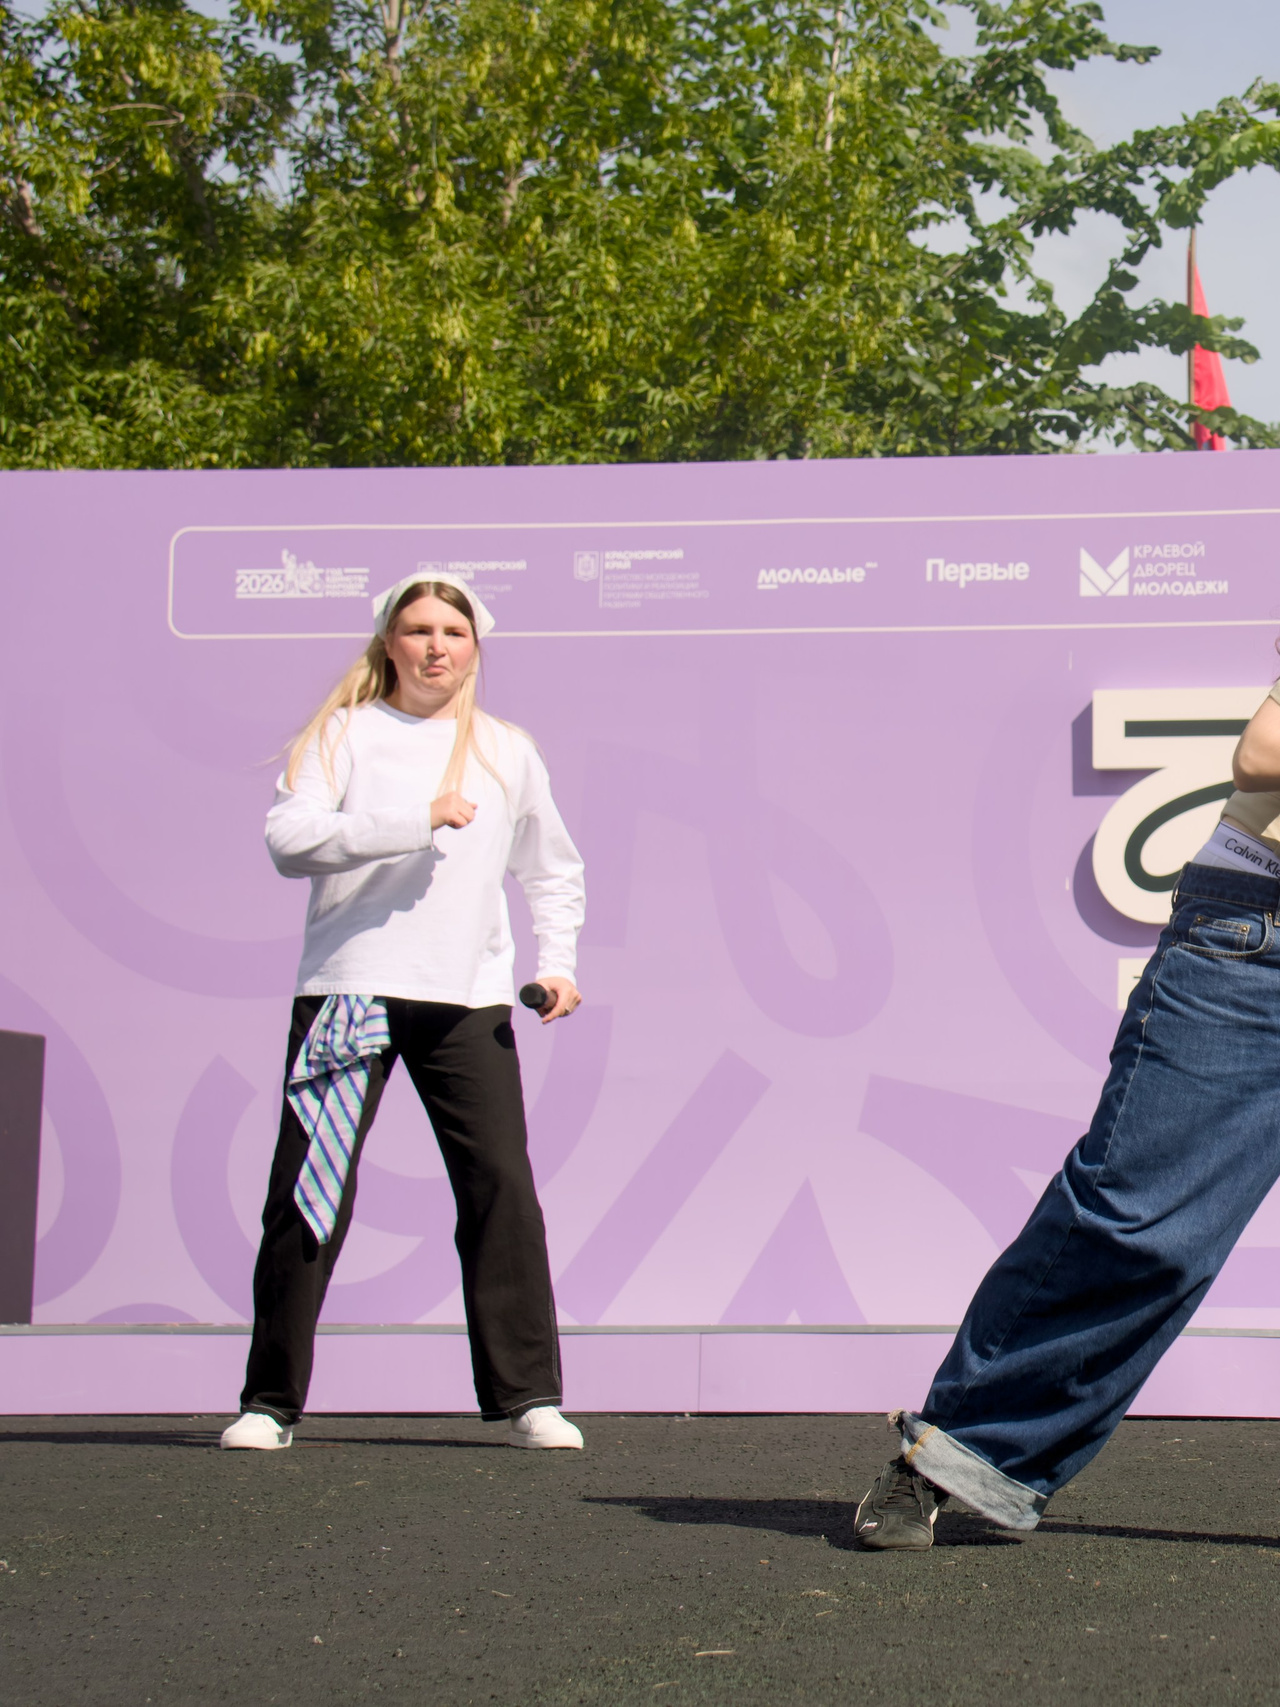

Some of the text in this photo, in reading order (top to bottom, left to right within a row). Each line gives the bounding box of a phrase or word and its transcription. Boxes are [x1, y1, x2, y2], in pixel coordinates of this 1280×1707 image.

[604, 548, 685, 560] КРАСНОЯРСКИЙ
[1134, 541, 1206, 558] КРАЕВОЙ
[447, 559, 527, 571] КРАСНОЯРСКИЙ
[604, 560, 632, 570] КРАЙ
[1133, 562, 1196, 578] ДВОРЕЦ
[757, 567, 866, 588] молодые
[926, 558, 1030, 589] Первые
[235, 574, 285, 593] 2026
[1133, 580, 1229, 596] МОЛОДЕЖИ
[1224, 838, 1264, 867] Calvin
